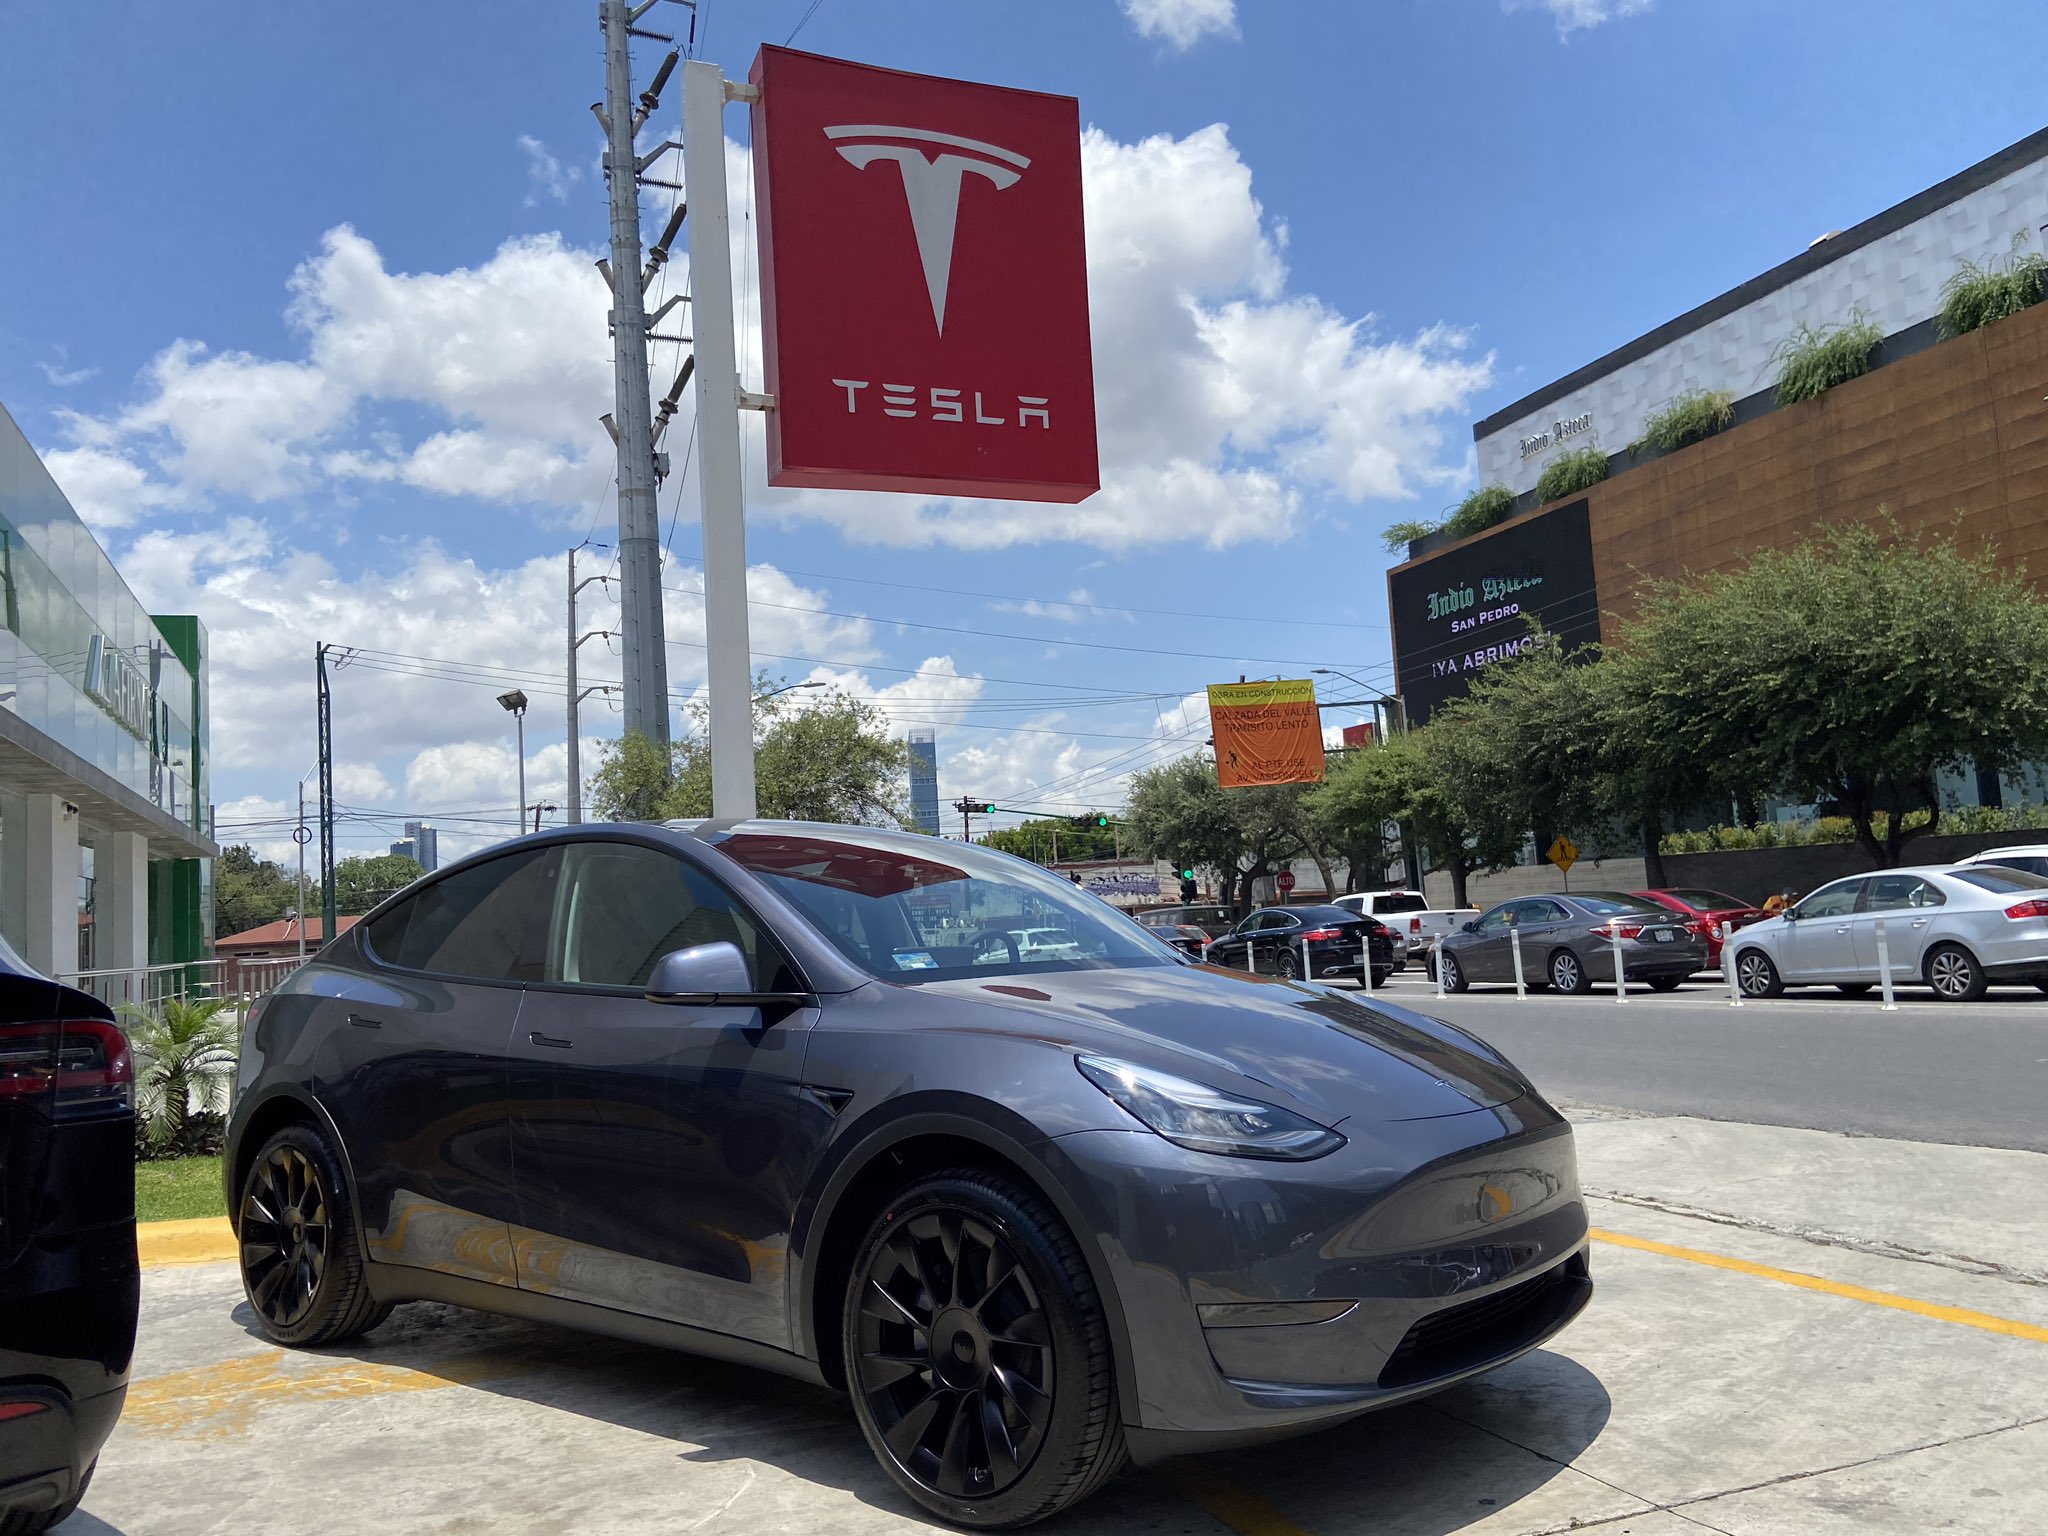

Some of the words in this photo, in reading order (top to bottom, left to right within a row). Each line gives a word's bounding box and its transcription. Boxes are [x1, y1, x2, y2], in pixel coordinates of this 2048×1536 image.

[831, 378, 1050, 429] TESLA
[1519, 432, 1549, 459] Indio
[1427, 581, 1474, 621] Indio
[1451, 617, 1475, 633] SAN
[1479, 603, 1519, 624] PEDRO
[1215, 710, 1260, 720] CALZADA
[1263, 709, 1281, 719] DEL
[1284, 706, 1314, 717] VALLE
[1276, 719, 1308, 730] LENTO
[1287, 758, 1306, 768] USE
[1254, 770, 1320, 780] VASCONCELO
[1278, 876, 1294, 886] ALTO
